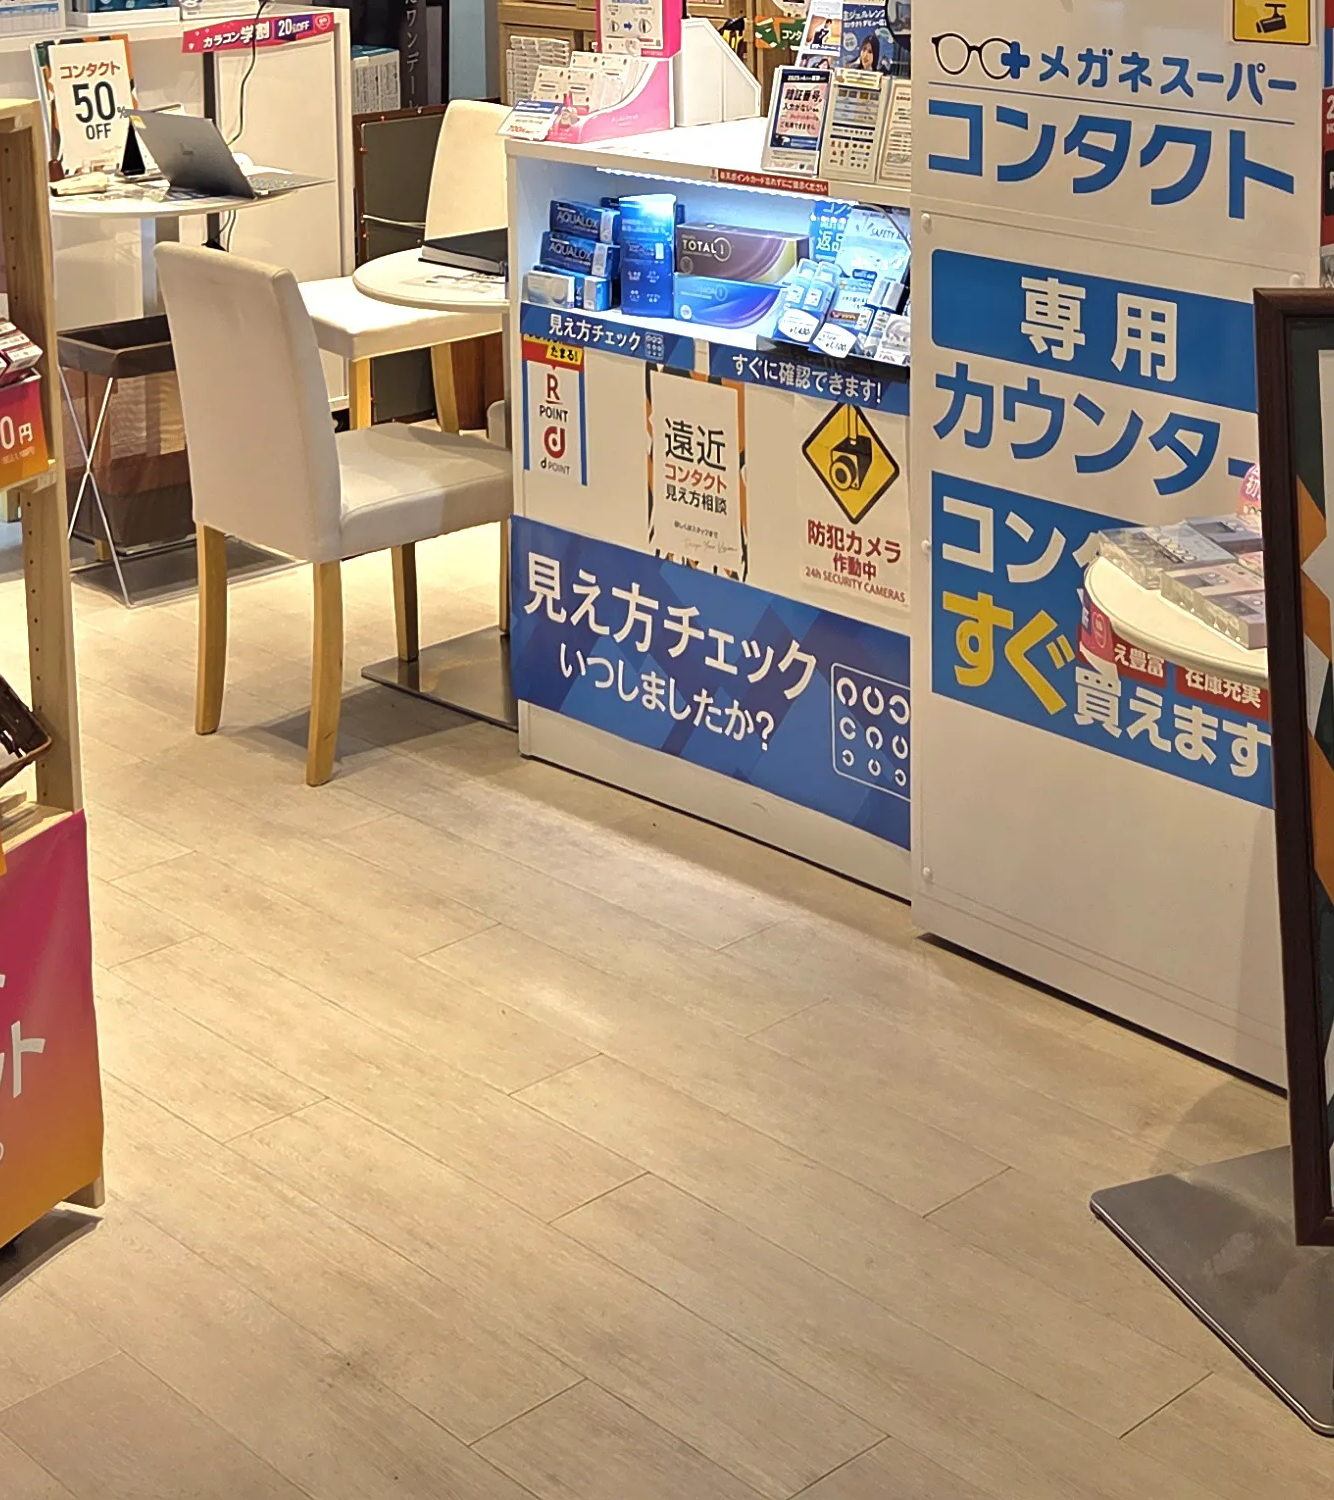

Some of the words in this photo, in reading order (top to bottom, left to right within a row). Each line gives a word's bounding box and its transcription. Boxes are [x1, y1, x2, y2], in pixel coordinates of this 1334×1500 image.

[60, 61, 120, 79] コンタクト
[1039, 45, 1297, 106] メガネスーパー
[86, 123, 112, 140] OFF
[927, 98, 1296, 220] コンタクト
[556, 211, 599, 228] AQUALOX
[548, 242, 593, 261] AQUALOX
[549, 314, 641, 352] 見え方チェック
[1021, 275, 1179, 382] 専用
[550, 348, 580, 363] たまる!
[732, 353, 882, 404] すぐに確認できます!
[540, 405, 569, 422] POINT
[933, 361, 1258, 497] カウンター
[665, 417, 726, 471] 遠近
[548, 461, 570, 475] POINT
[665, 463, 727, 493] コンタクト
[665, 486, 727, 516] 見え方相談
[807, 519, 901, 564] 防犯カメラ
[805, 566, 821, 579] 24h
[823, 570, 862, 591] SECURITY
[863, 581, 906, 603] CAMERAS
[832, 556, 877, 581] 作動中
[524, 551, 817, 699] 見え方チェック
[559, 643, 776, 751] いつしましたか?
[1185, 667, 1261, 708] 在庫充実
